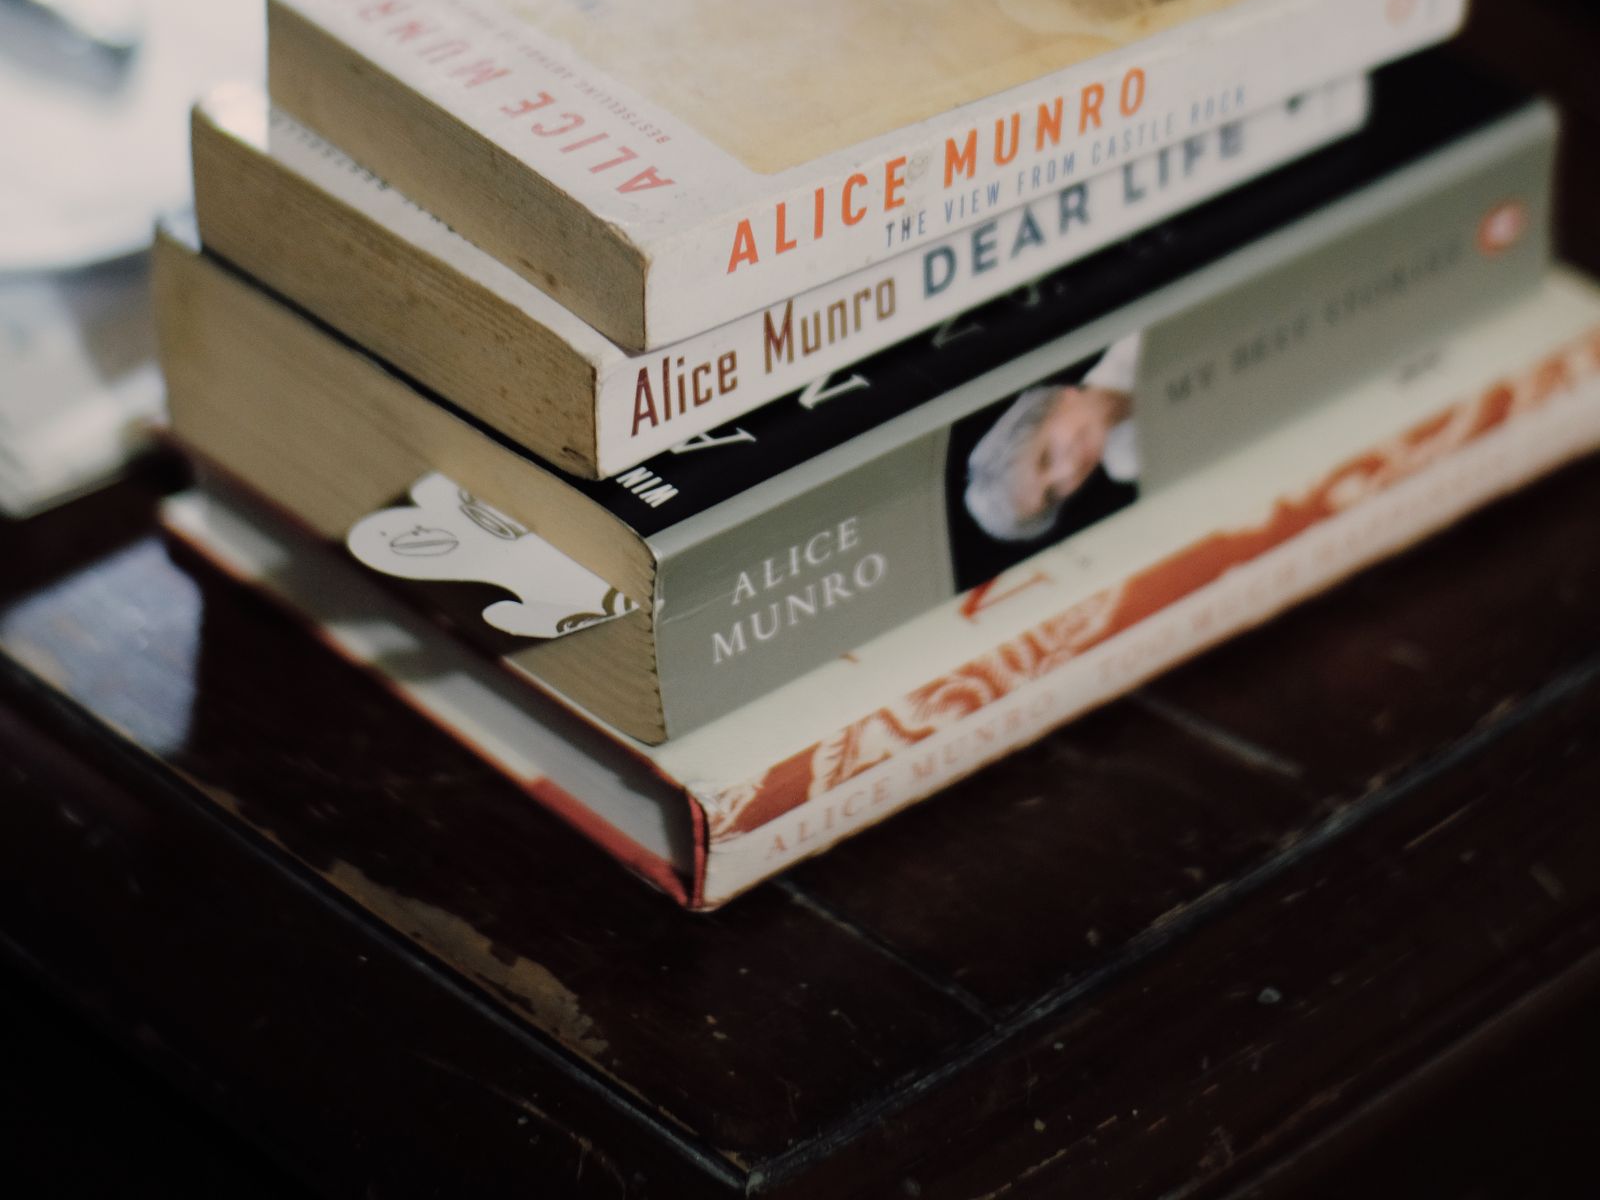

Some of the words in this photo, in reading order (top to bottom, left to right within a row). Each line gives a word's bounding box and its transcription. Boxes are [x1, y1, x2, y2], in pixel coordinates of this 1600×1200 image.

[500, 90, 676, 194] ALICE
[727, 156, 906, 275] ALICE
[944, 67, 1146, 190] MUNRO
[886, 210, 926, 248] THE
[945, 180, 999, 224] VIEW
[1017, 152, 1075, 195] FROM
[1092, 111, 1174, 167] CASTLE
[631, 350, 738, 437] Alice
[763, 277, 896, 375] Munro
[923, 181, 1090, 300] DEAR
[1123, 120, 1244, 207] LIFE
[712, 552, 886, 665] MUNRO
[732, 517, 859, 606] ALICE
[768, 776, 892, 860] ALICE
